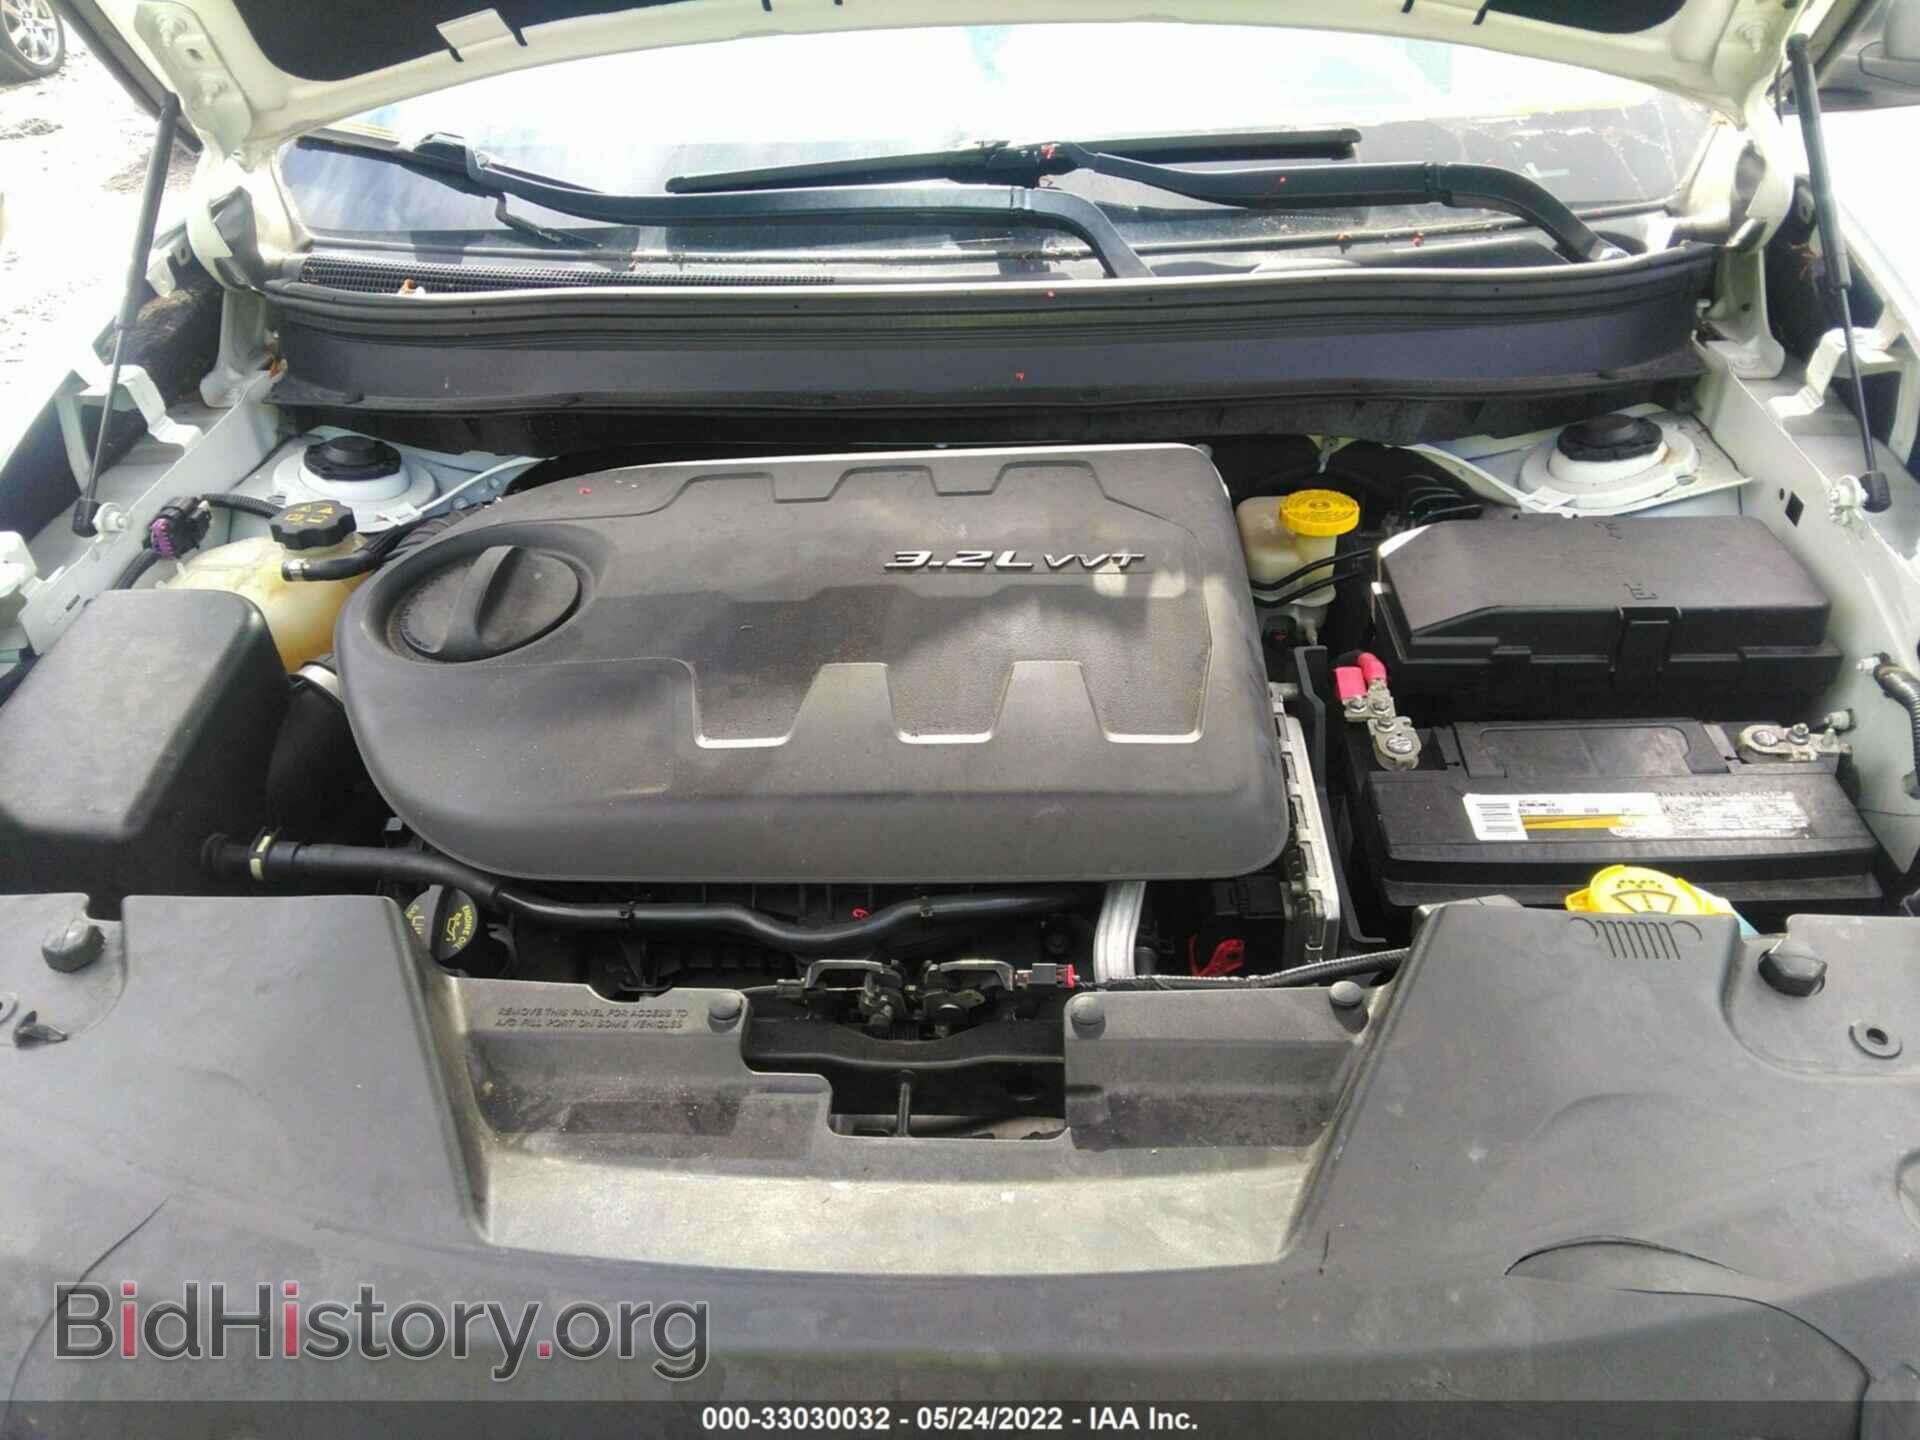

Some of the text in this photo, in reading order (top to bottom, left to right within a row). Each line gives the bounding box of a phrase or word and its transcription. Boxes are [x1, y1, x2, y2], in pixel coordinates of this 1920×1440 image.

[884, 550, 1146, 570] 3.2L VVT
[461, 904, 473, 935] ENGINE
